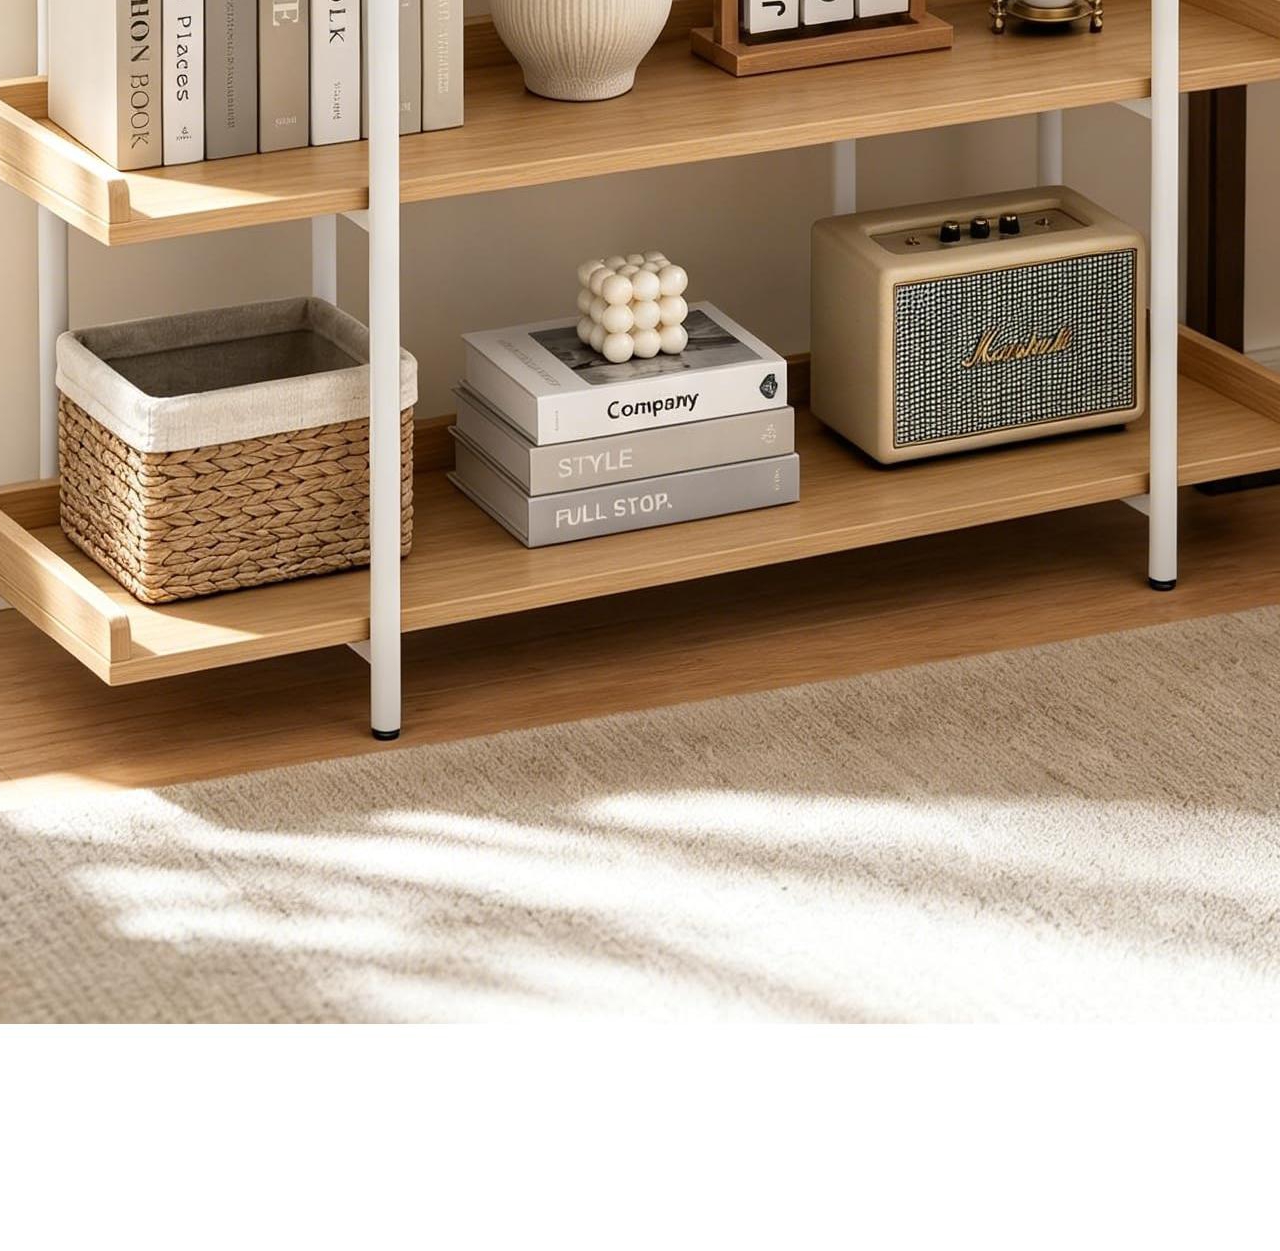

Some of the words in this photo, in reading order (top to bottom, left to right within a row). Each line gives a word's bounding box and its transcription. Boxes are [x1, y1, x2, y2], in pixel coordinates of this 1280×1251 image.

[176, 15, 192, 102] Places
[130, 74, 150, 149] BOOK
[607, 393, 699, 419] Company
[558, 448, 633, 478] STYLE
[555, 503, 608, 528] FULL
